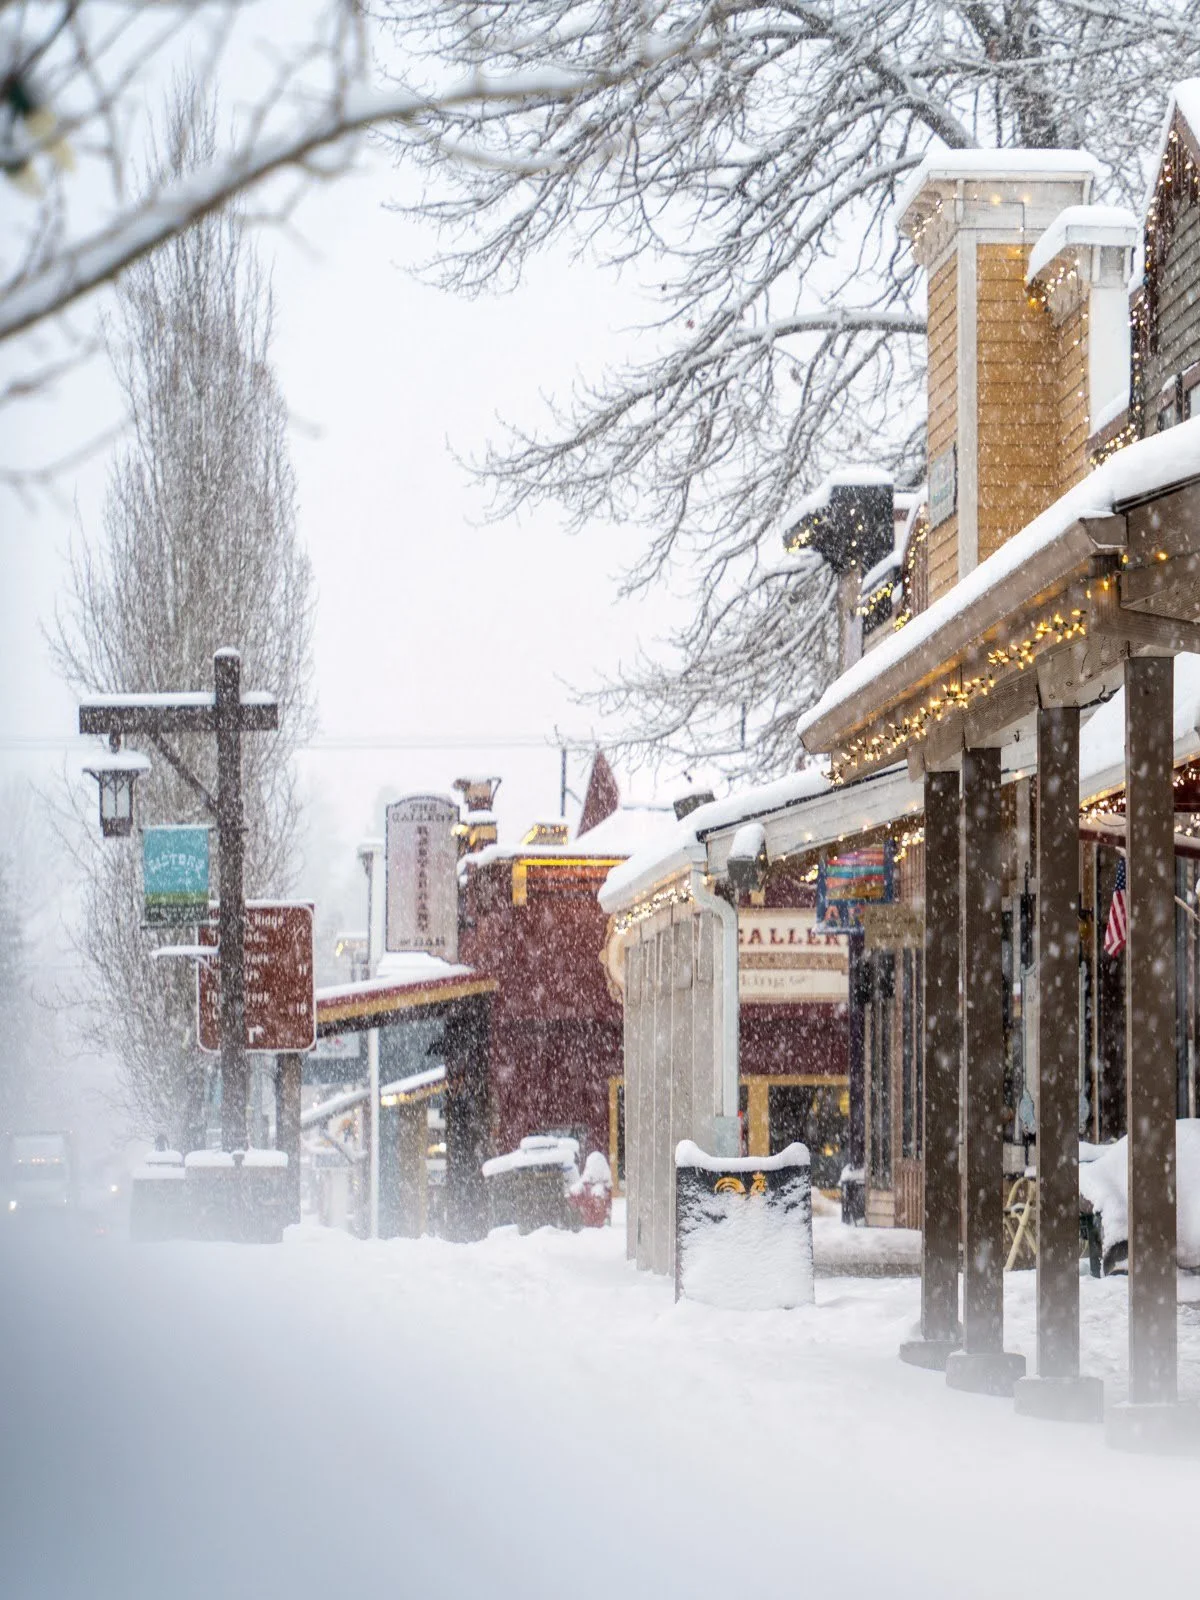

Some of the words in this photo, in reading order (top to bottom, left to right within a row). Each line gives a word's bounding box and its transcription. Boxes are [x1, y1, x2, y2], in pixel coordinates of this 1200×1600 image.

[254, 914, 284, 929] Ridge
[739, 927, 842, 945] ALLER
[246, 953, 269, 965] reek
[246, 991, 269, 1003] reek
